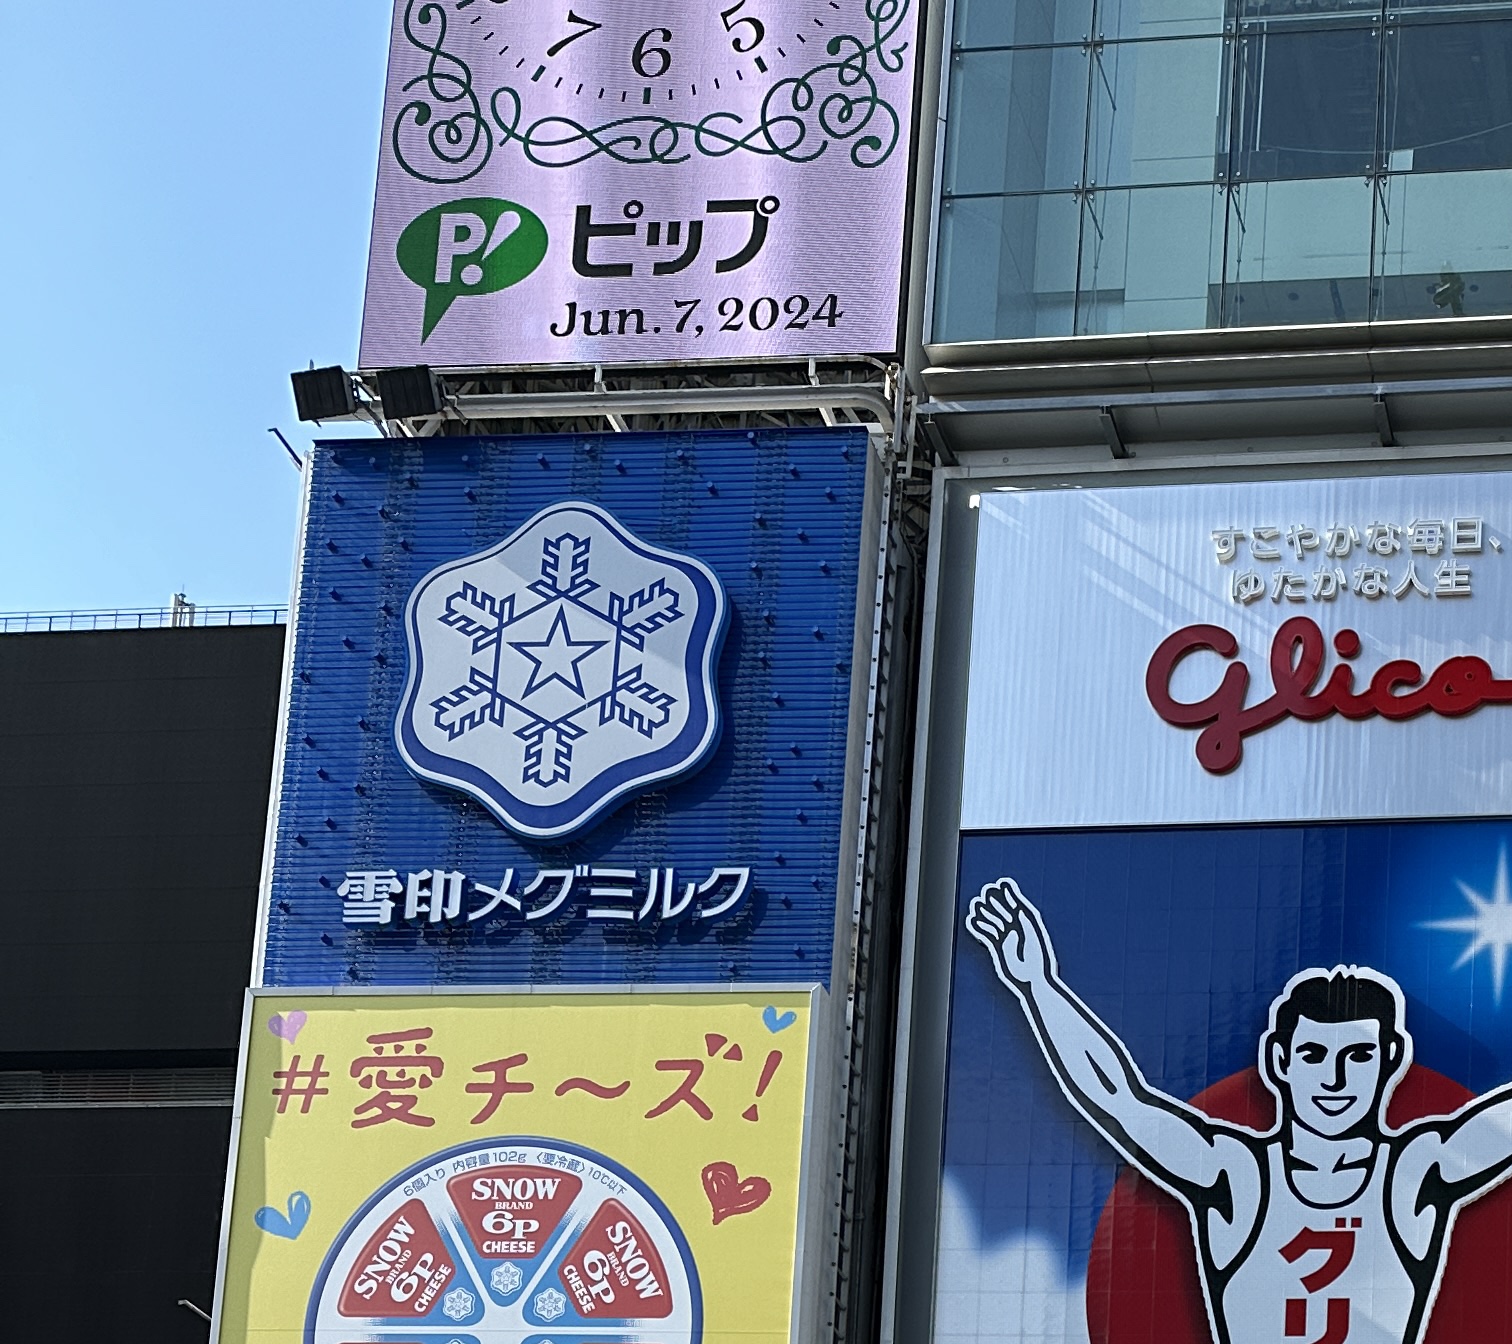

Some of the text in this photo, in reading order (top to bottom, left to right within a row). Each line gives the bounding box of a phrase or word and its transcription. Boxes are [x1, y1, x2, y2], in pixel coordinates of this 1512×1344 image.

[571, 195, 781, 278] ピップ
[717, 293, 844, 332] 2024
[1210, 515, 1503, 564] すこやかな毎日、
[1229, 557, 1472, 604] ゆたかな人生
[336, 866, 752, 924] 雪印メグミルク
[471, 1177, 562, 1201] SNOW
[494, 1201, 534, 1210] BRAND
[353, 1215, 416, 1301] SNOW
[482, 1240, 536, 1254] CHEESE
[605, 1219, 665, 1301] SNOW
[413, 1263, 452, 1314] CHEESE
[562, 1263, 596, 1315] CHEESE
